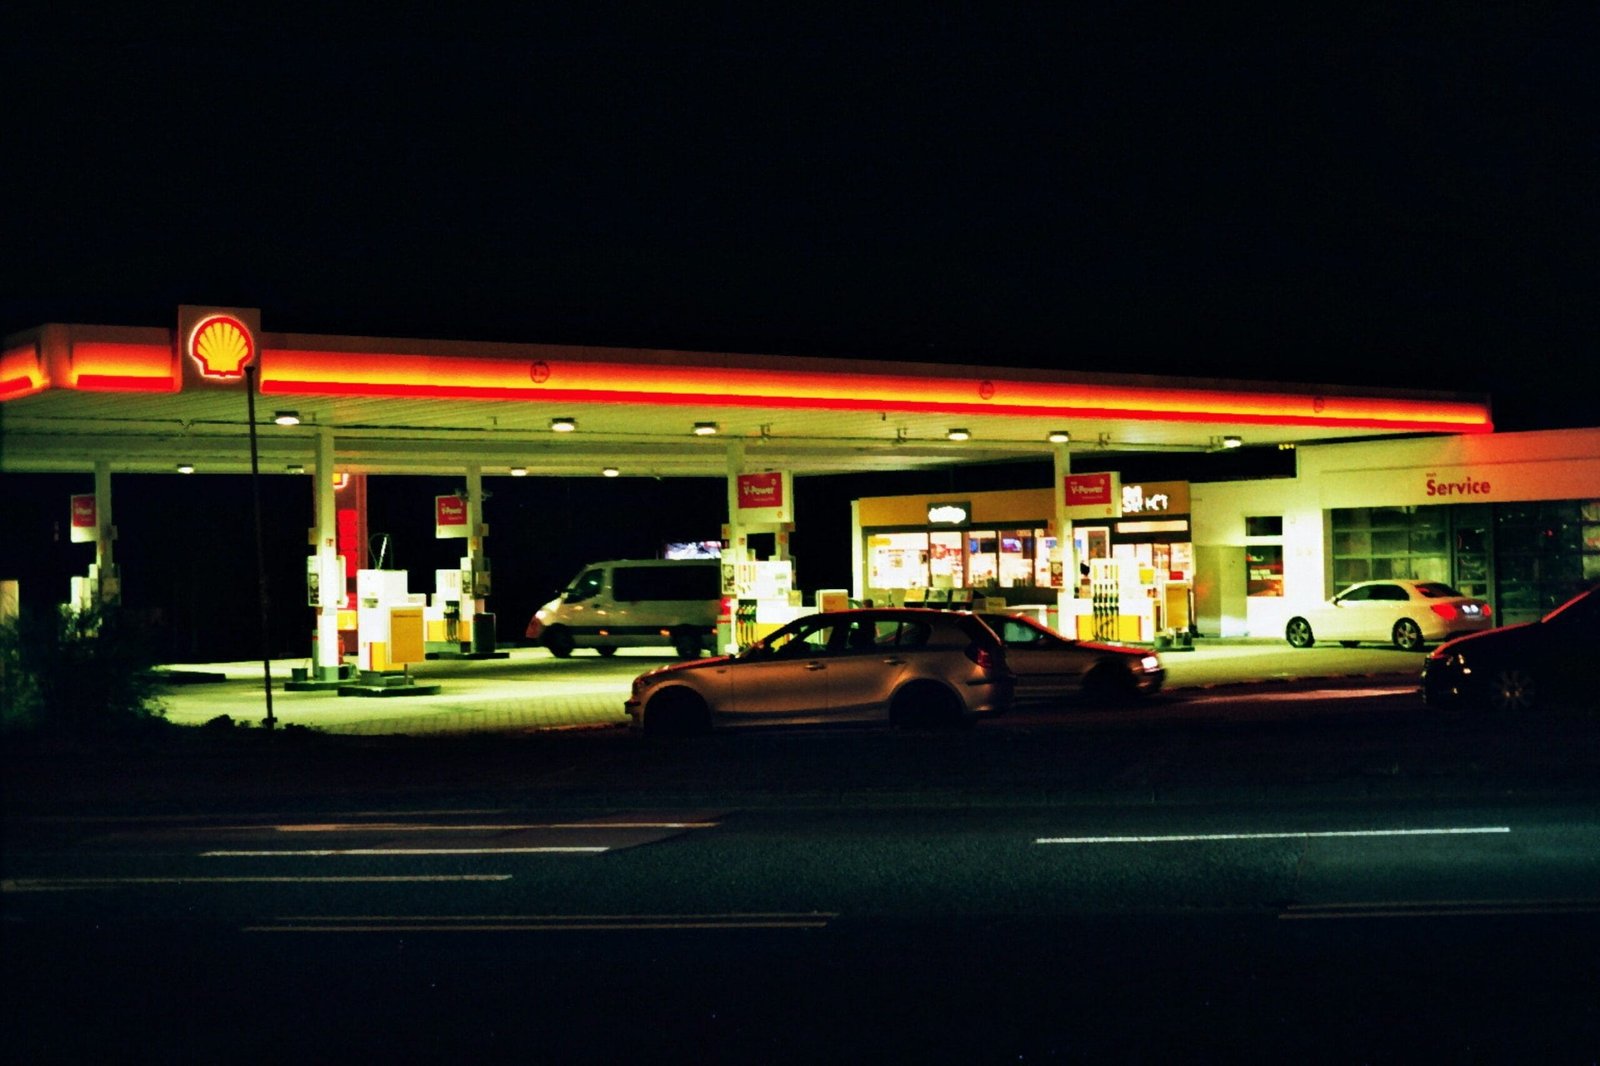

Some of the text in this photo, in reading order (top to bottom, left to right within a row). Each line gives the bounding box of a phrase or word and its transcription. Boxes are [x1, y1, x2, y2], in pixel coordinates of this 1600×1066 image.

[743, 486, 774, 495] V-Power
[1070, 485, 1103, 494] V-Power
[1426, 477, 1491, 496] Service
